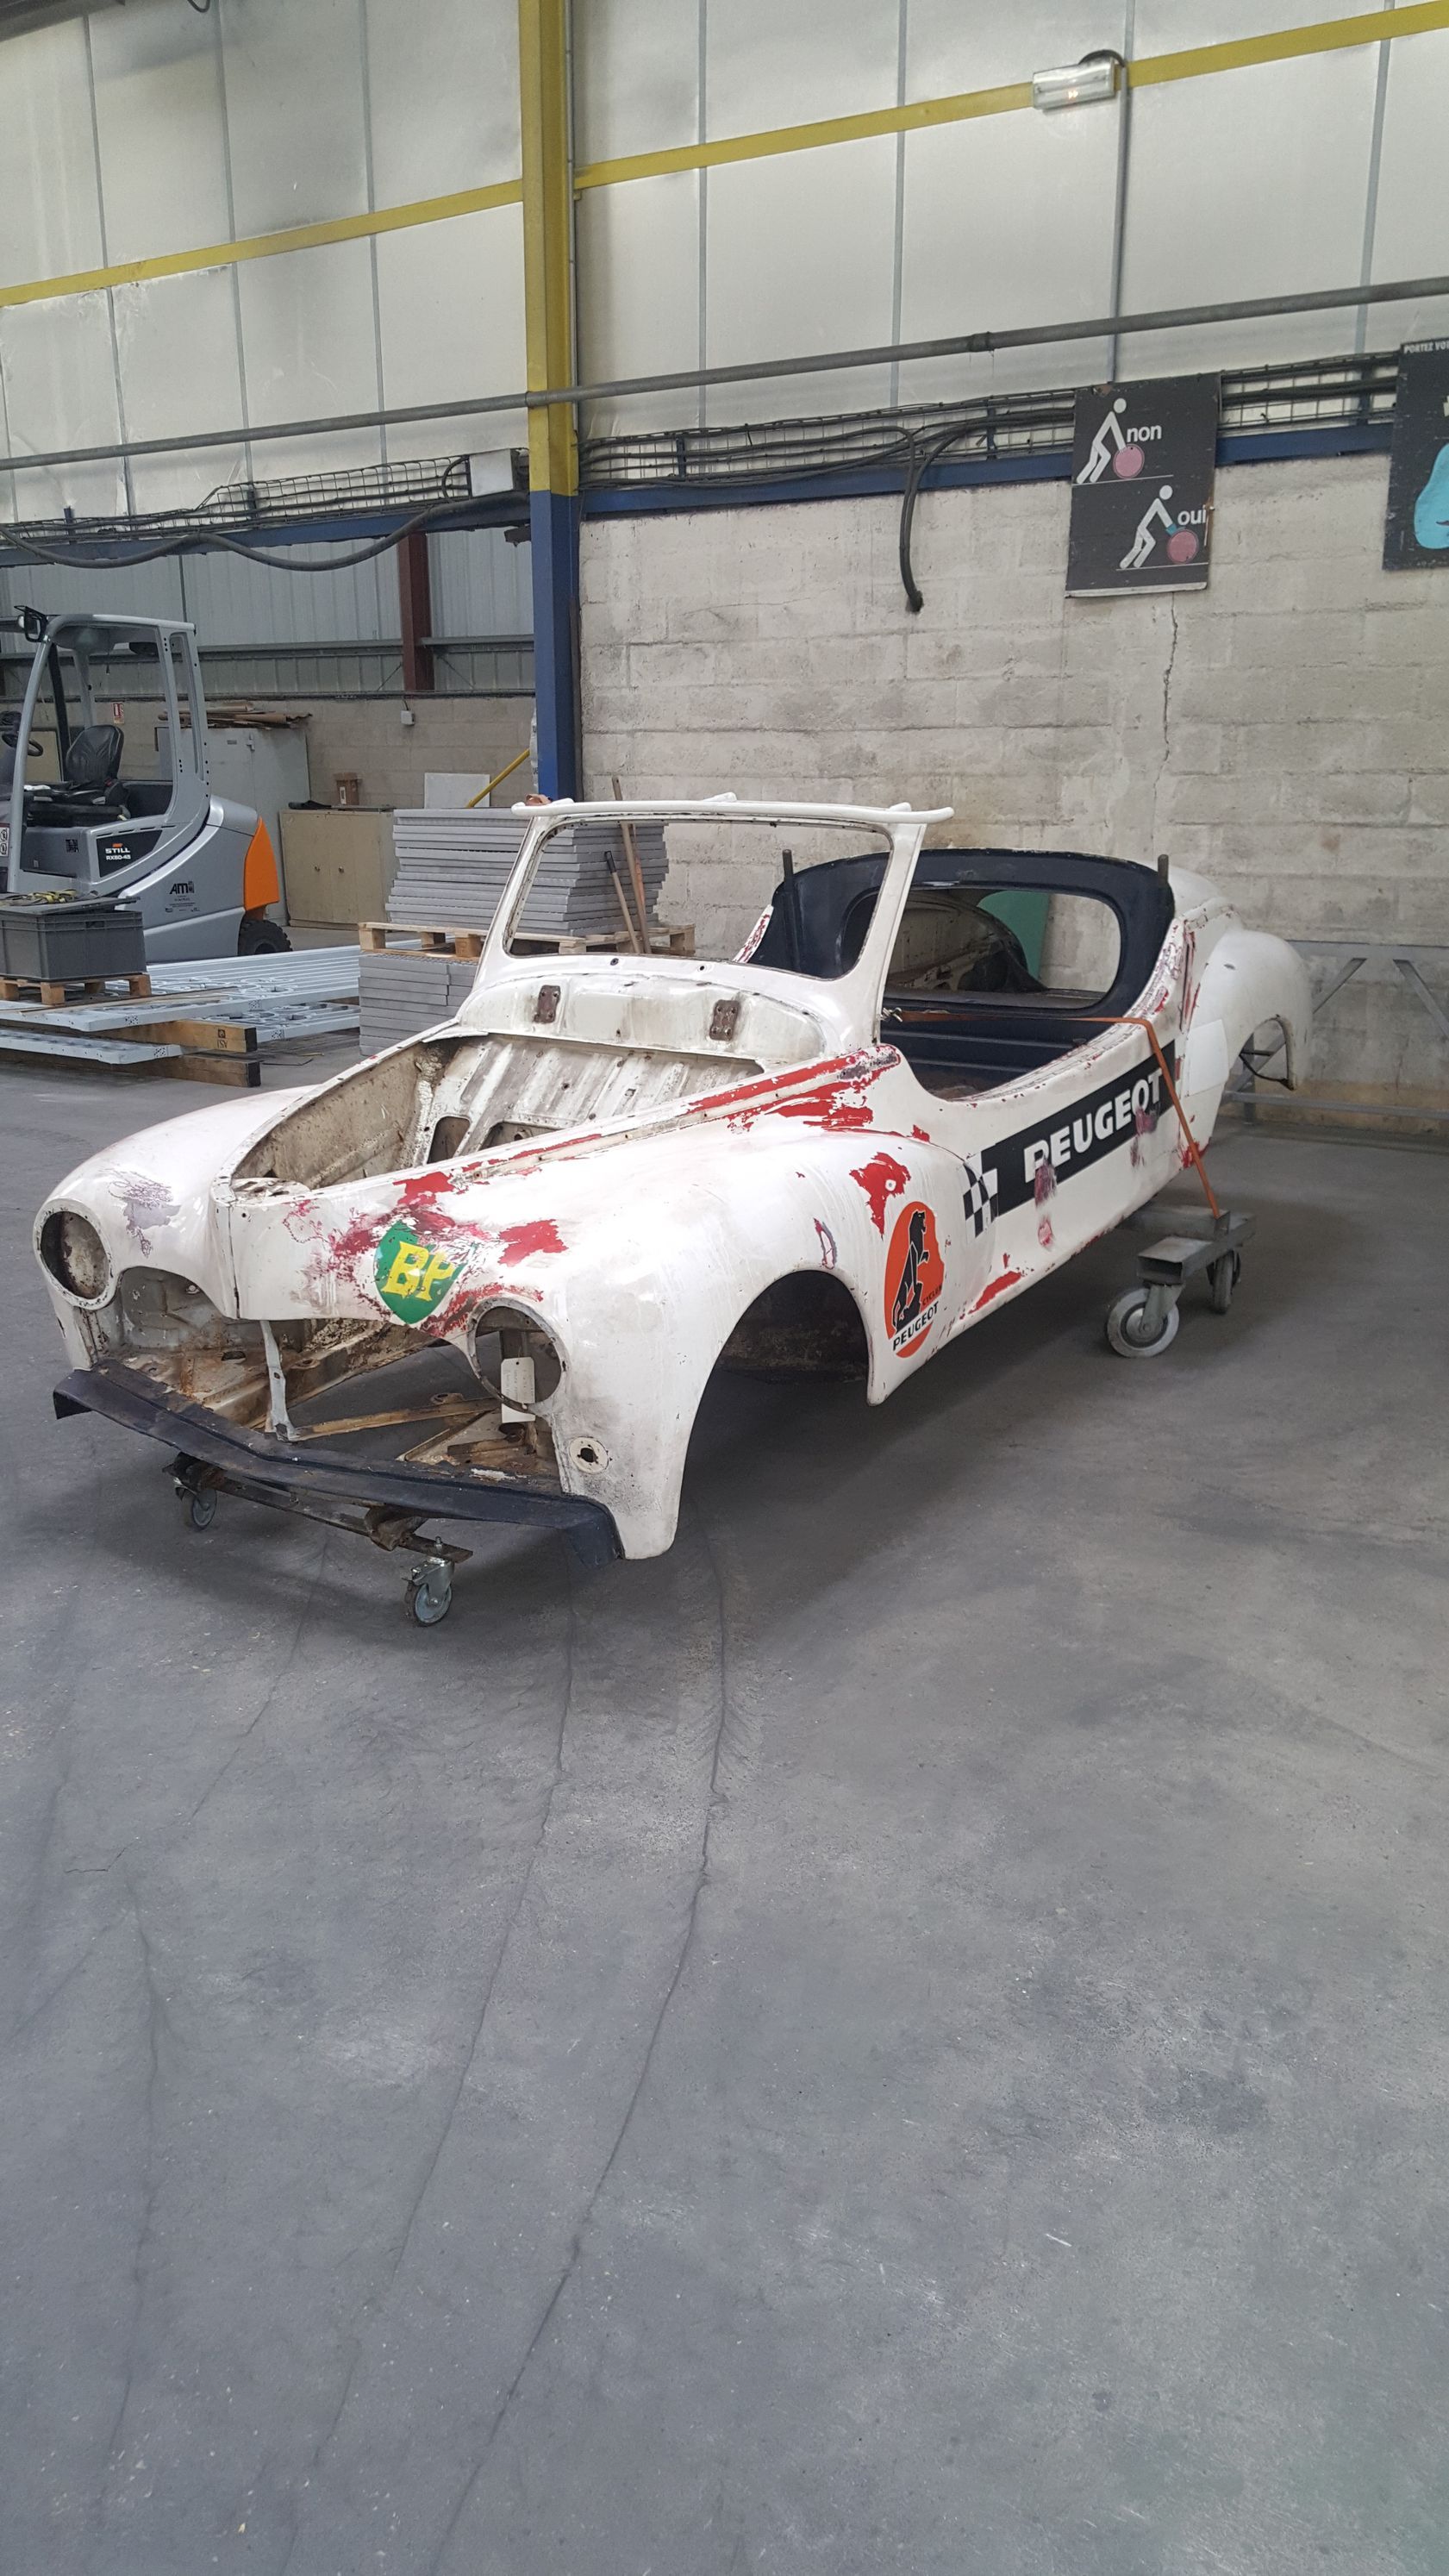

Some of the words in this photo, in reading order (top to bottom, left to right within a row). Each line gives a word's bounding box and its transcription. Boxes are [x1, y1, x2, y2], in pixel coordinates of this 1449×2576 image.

[1127, 425, 1162, 443] non
[1177, 504, 1207, 526] oui
[1023, 1067, 1162, 1184] PEUGEOT
[380, 1241, 456, 1302] BP
[893, 1300, 939, 1351] PEUGEOT
